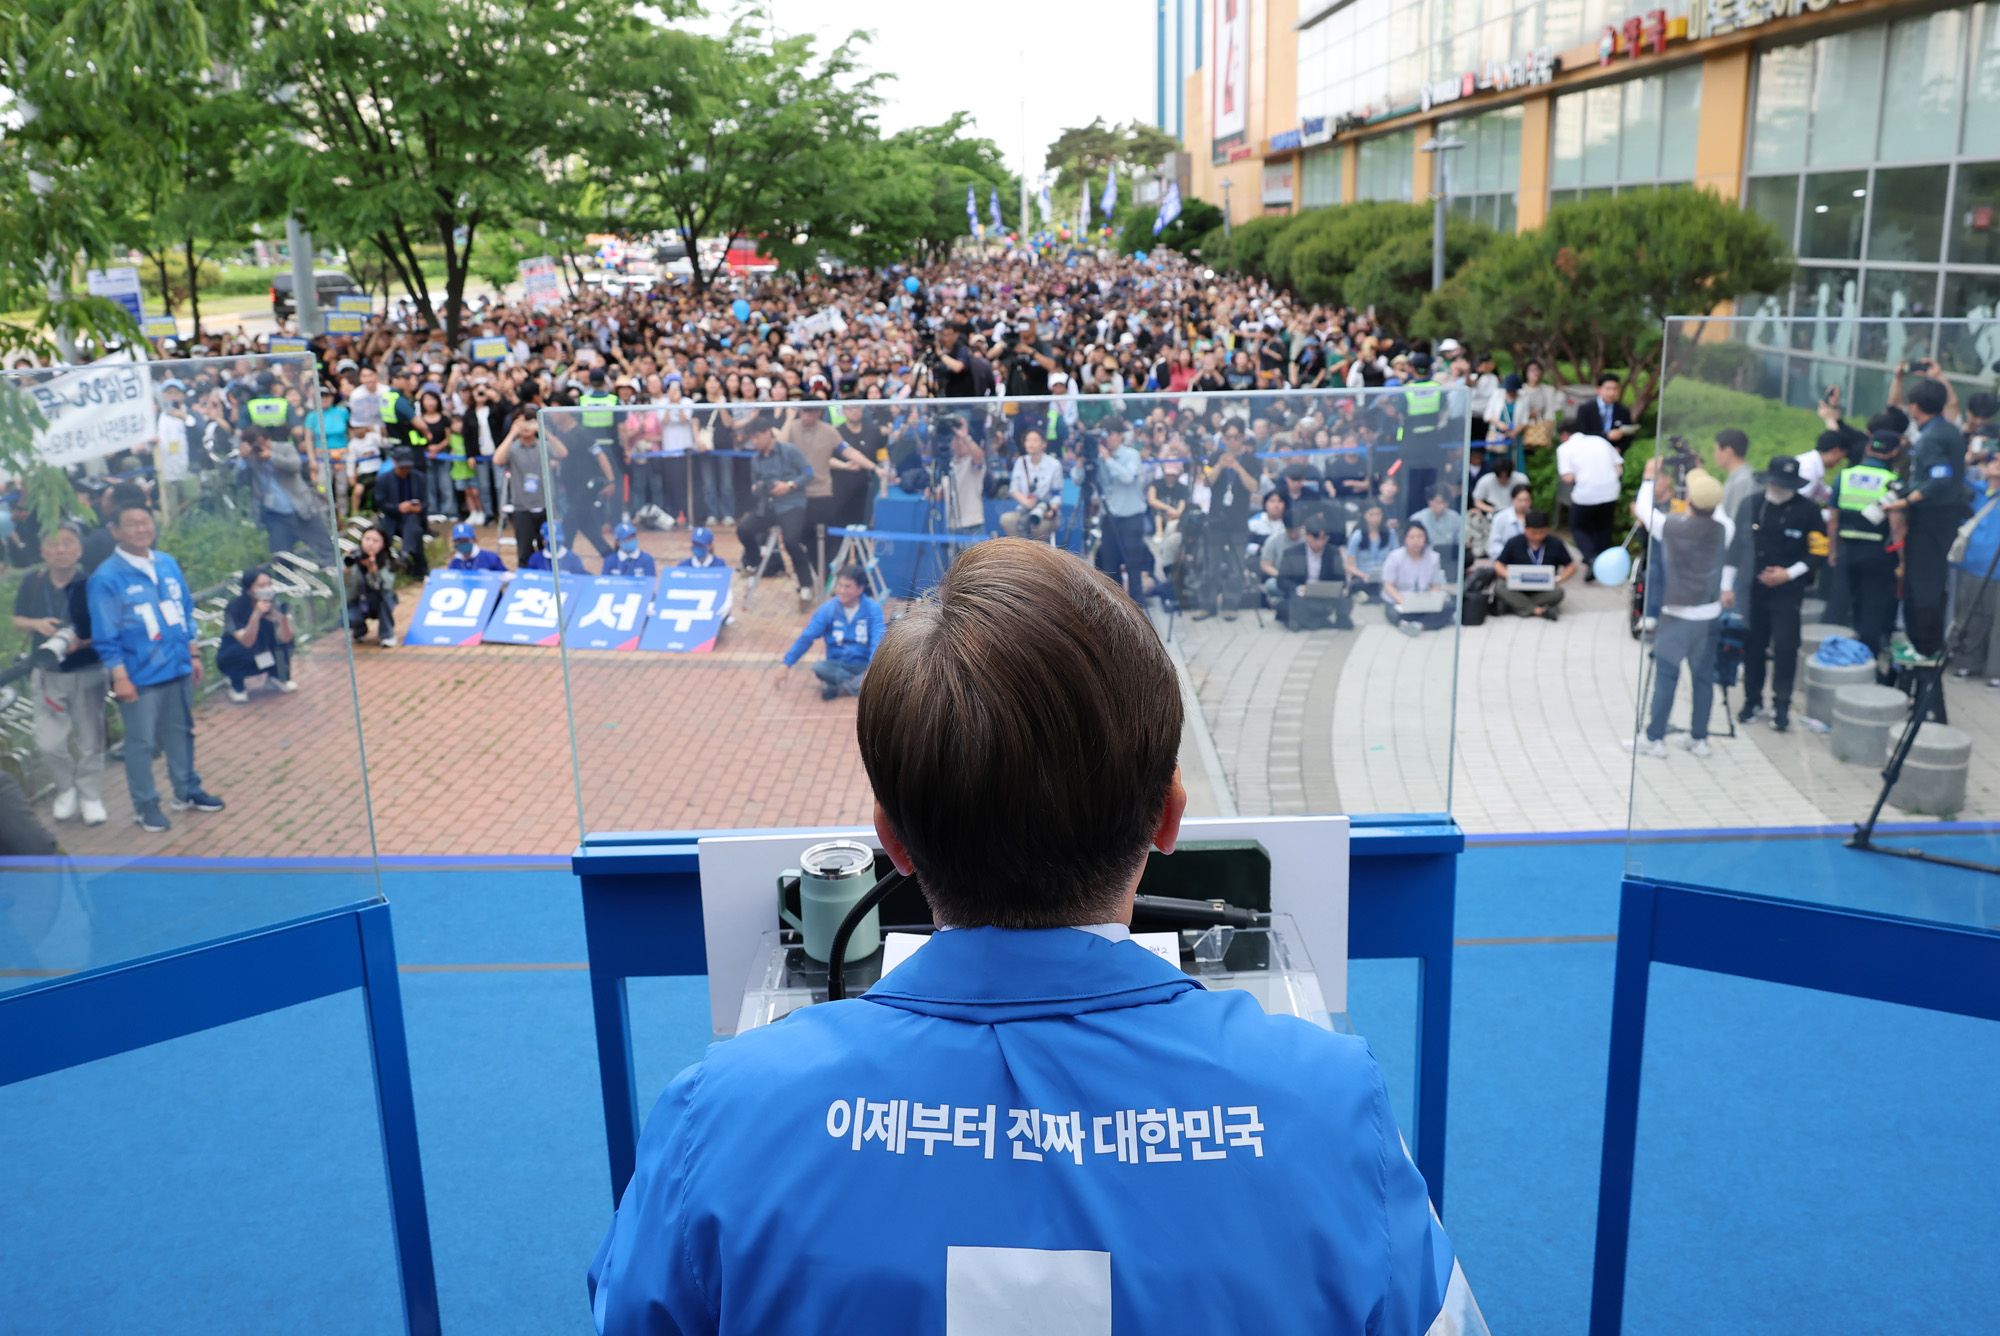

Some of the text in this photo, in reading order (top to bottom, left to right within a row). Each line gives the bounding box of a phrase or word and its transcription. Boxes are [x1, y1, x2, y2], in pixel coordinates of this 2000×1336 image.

[827, 1096, 1265, 1165] 이제부터 진짜 대한민국
